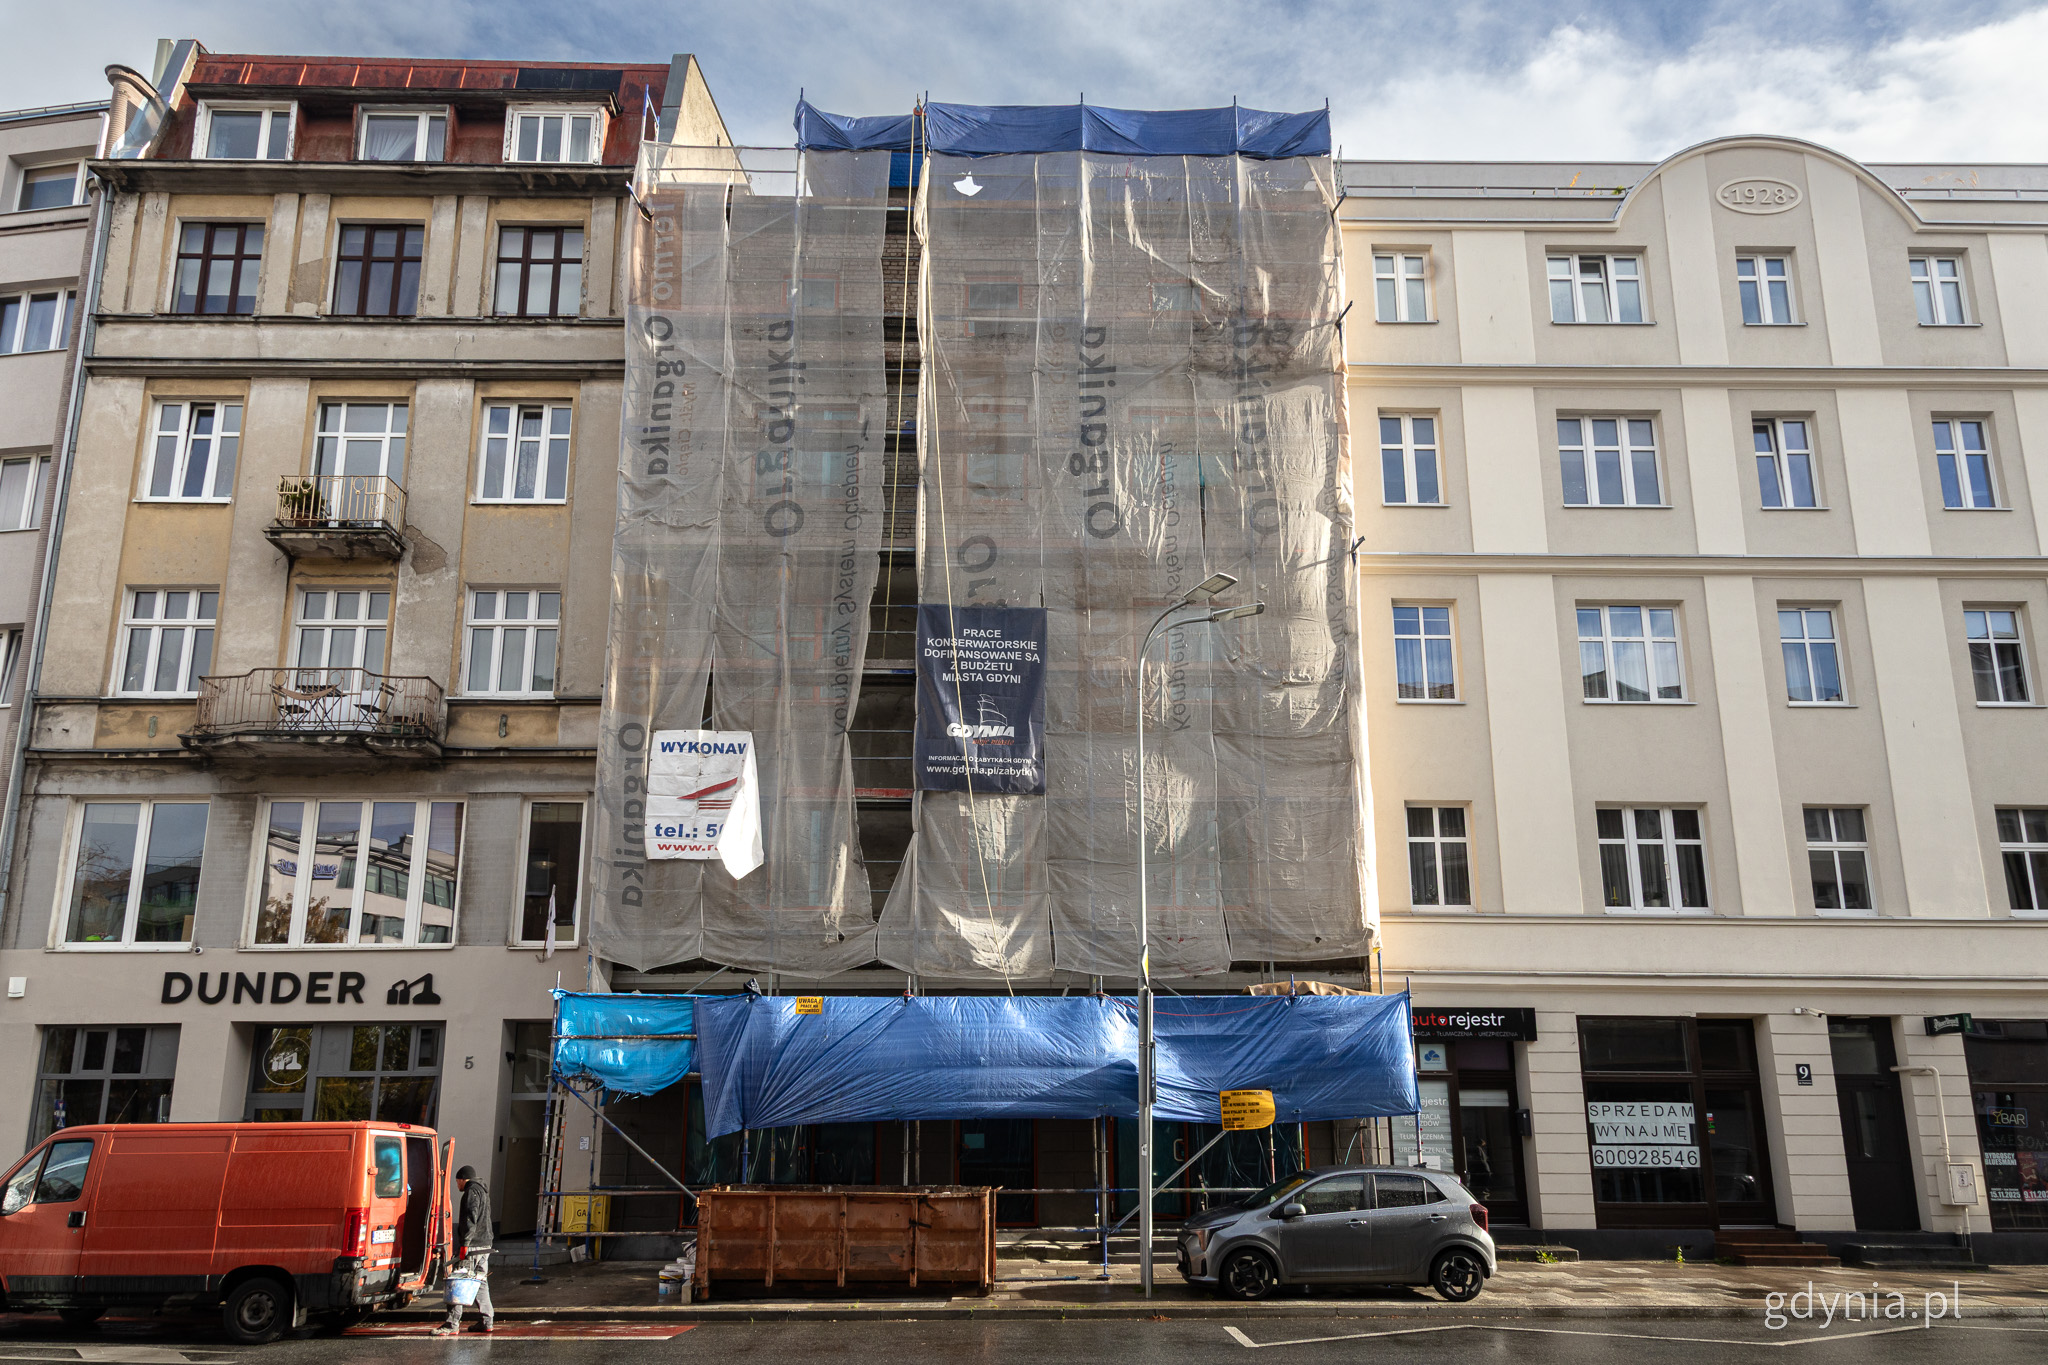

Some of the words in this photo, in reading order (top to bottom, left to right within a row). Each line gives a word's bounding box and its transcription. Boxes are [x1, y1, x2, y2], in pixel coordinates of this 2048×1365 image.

[1731, 187, 1787, 204] 1928
[963, 629, 1001, 638] PRACE
[927, 638, 1038, 650] KONSERWATORSKIE
[924, 648, 1022, 660] DOFINANSOWANE
[1025, 652, 1040, 663] SĄ
[950, 661, 957, 670] Z
[960, 660, 1013, 671] BUDŻETU
[942, 673, 983, 682] MIASTA
[986, 674, 1021, 683] GDYNI
[946, 723, 1015, 738] GDYNIA
[926, 765, 1033, 777] www.gdynia.pl/zabytki
[654, 823, 698, 838] tel.:
[161, 971, 366, 1004] DUNDER
[1412, 1012, 1505, 1030] autorejestr
[464, 1056, 474, 1070] 5
[1799, 1066, 1808, 1079] 9
[1589, 1105, 1694, 1117] SPRZEDAM
[2001, 1113, 2026, 1125] BAR
[1596, 1125, 1687, 1140] WYNAJMĘ
[1594, 1149, 1698, 1165] 600928546
[1990, 1191, 2021, 1199] 15.11.2025
[576, 1209, 588, 1217] GA
